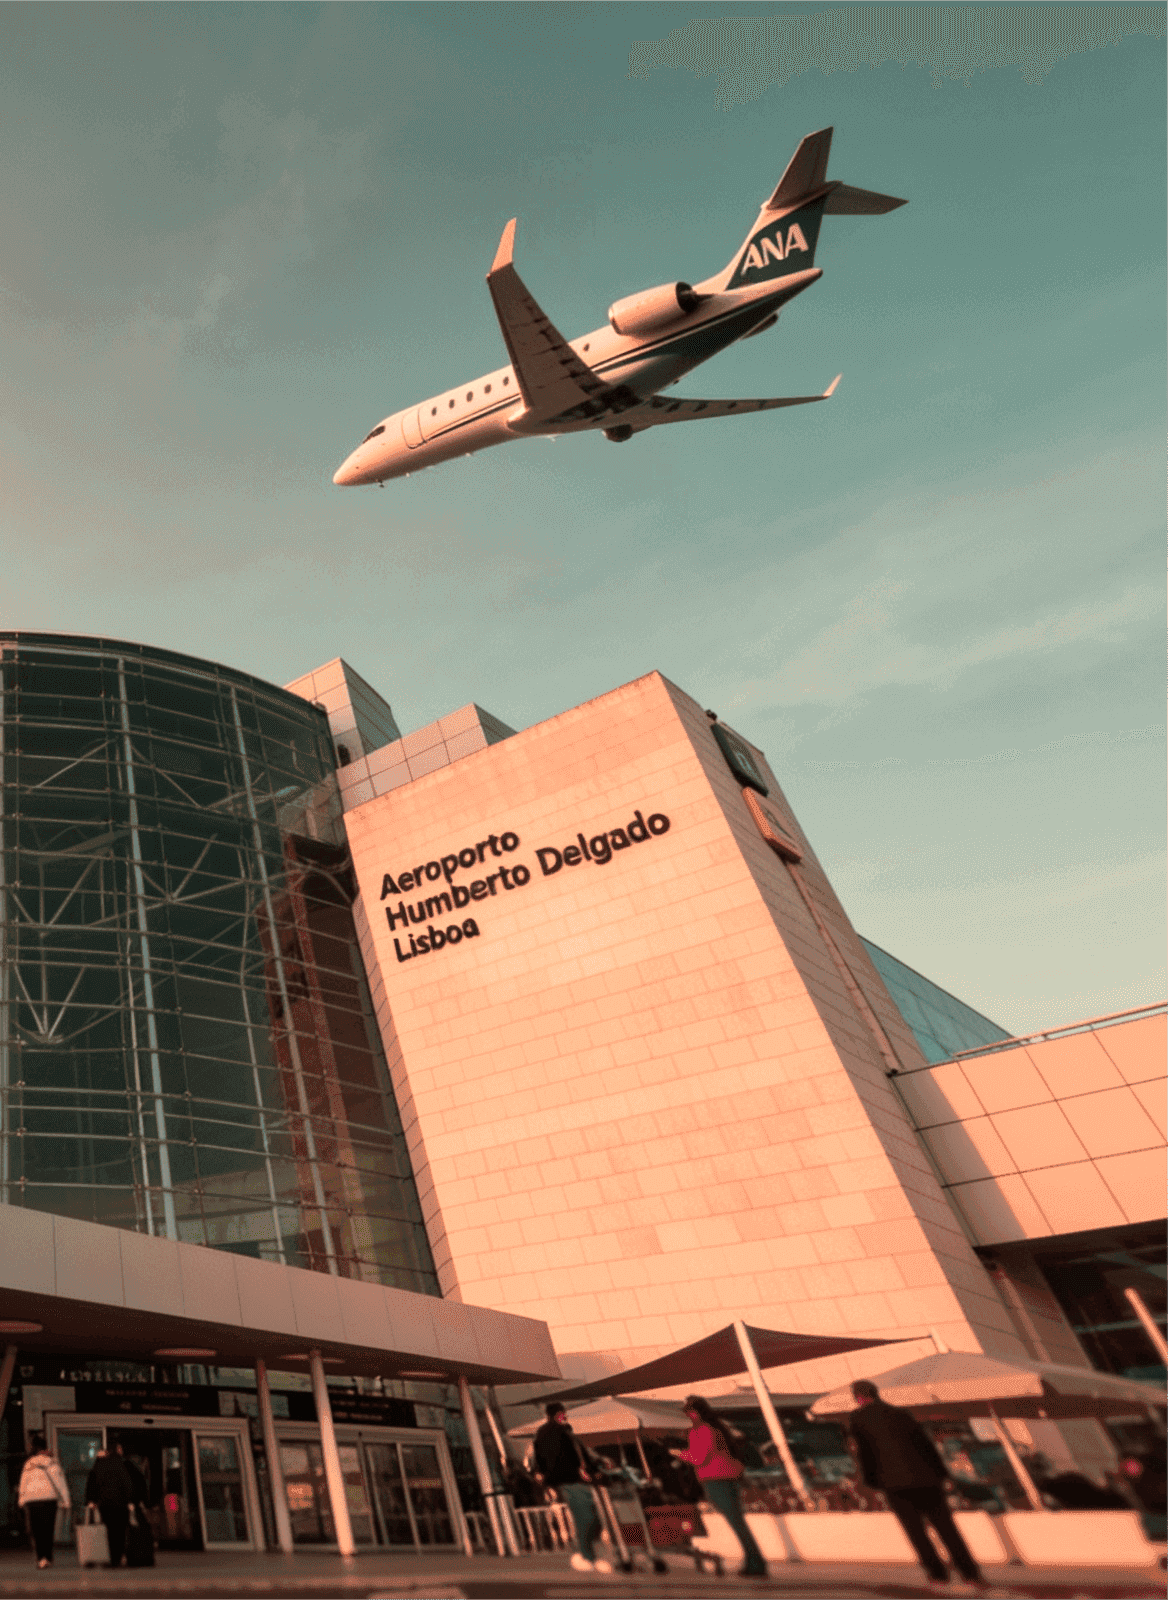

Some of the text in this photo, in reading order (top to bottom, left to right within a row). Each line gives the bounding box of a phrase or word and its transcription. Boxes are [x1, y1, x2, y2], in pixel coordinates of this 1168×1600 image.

[740, 222, 819, 276] ANA
[380, 832, 520, 900] Aeroporto
[385, 810, 670, 931] Humberto Delgado
[393, 918, 480, 962] Lisboa
